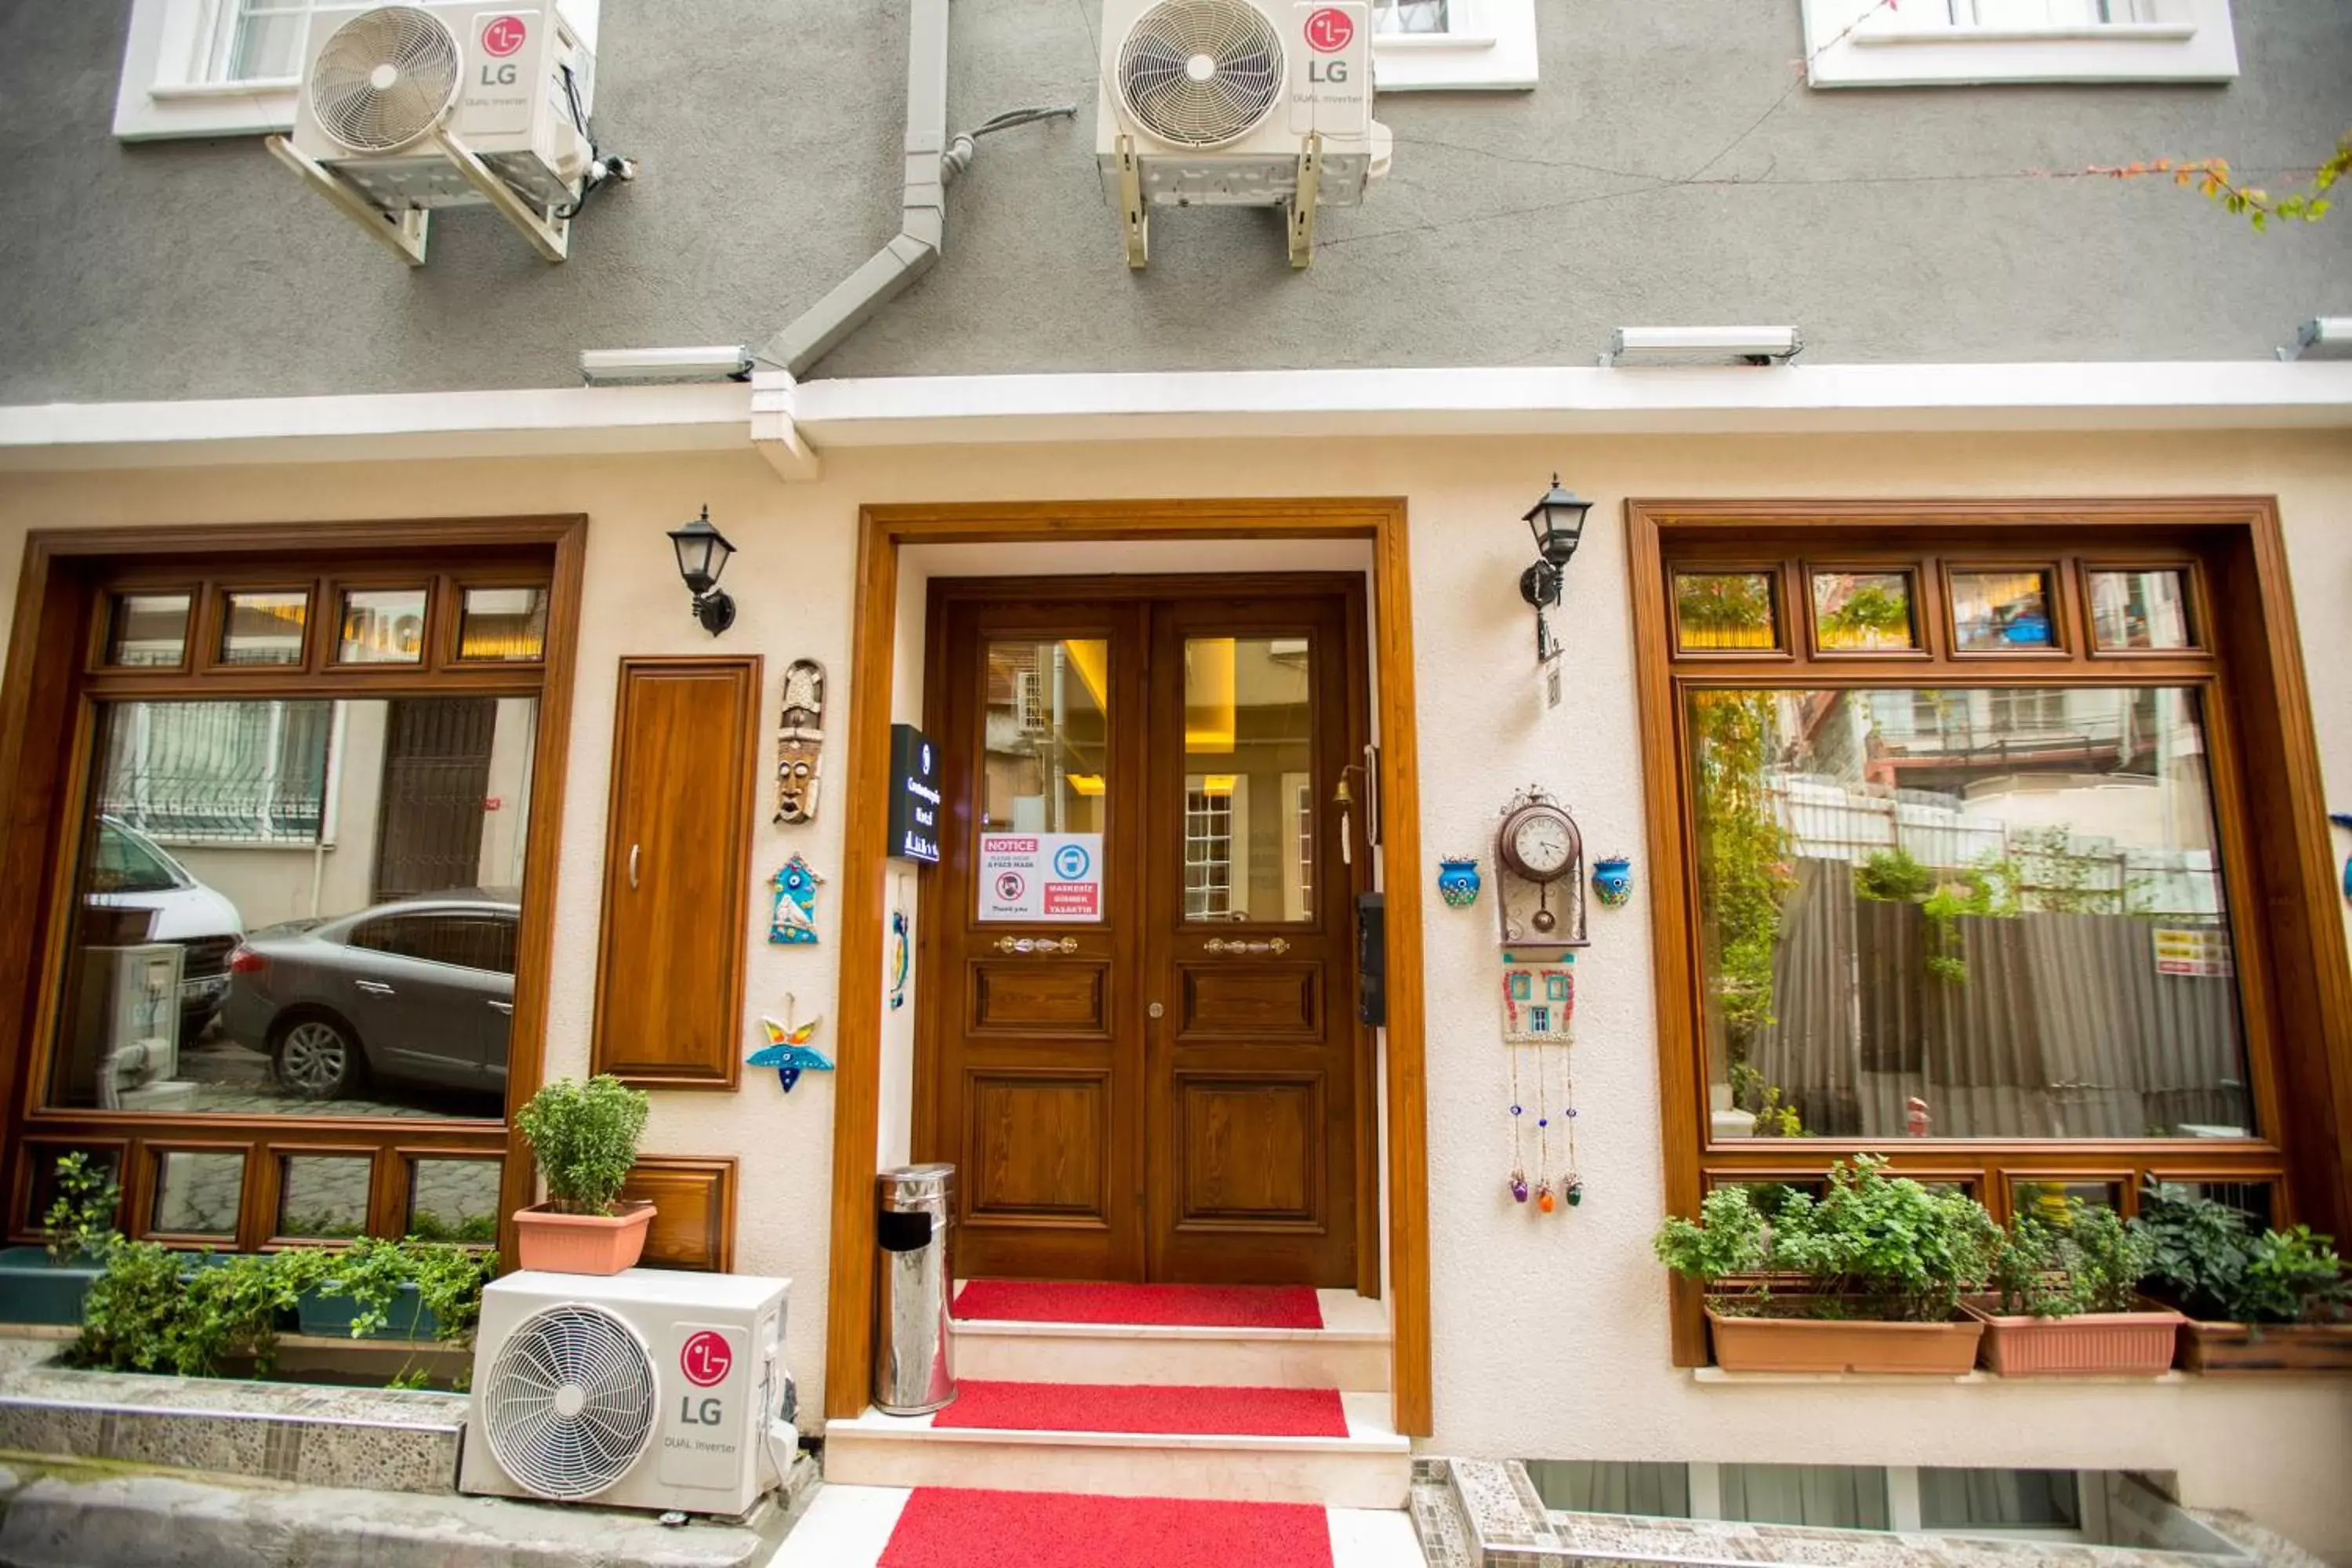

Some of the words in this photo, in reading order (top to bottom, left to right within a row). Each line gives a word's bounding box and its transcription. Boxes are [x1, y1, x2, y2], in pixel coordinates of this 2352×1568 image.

[481, 64, 517, 85] LG
[1308, 60, 1348, 83] LG
[988, 840, 1035, 851] NOTICE
[681, 1396, 722, 1426] LG
[664, 1436, 691, 1450] DUAL
